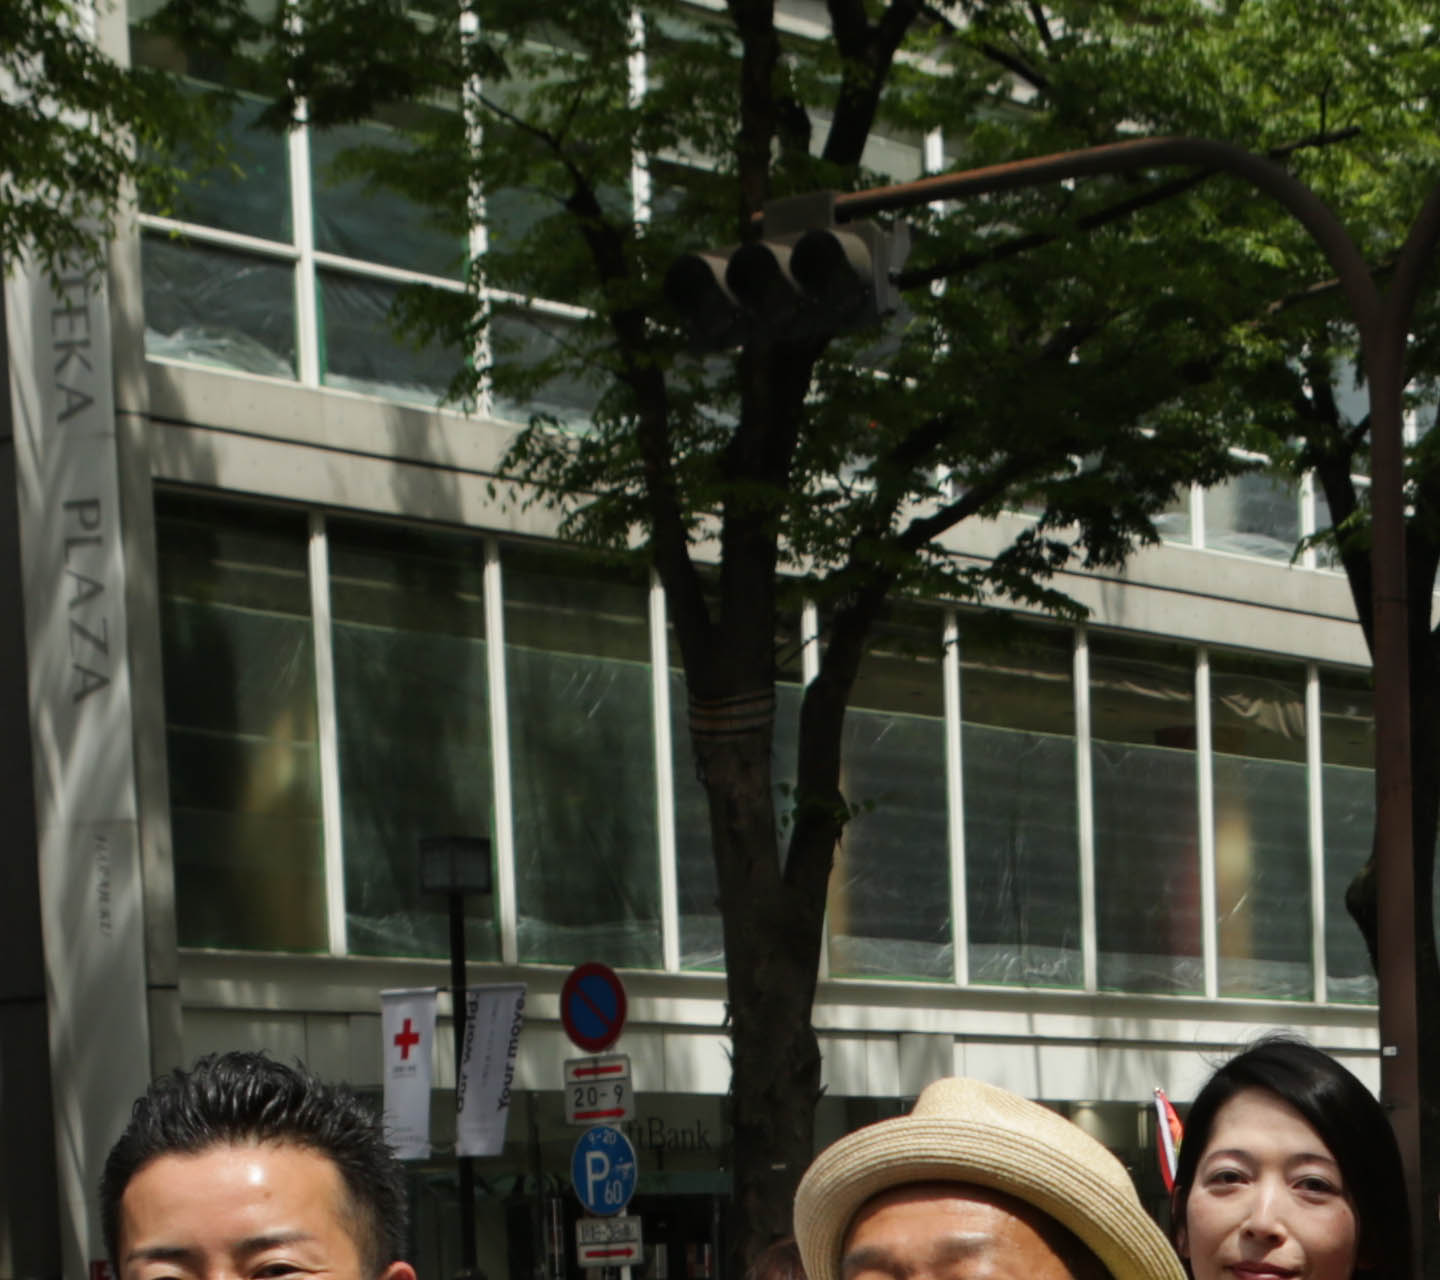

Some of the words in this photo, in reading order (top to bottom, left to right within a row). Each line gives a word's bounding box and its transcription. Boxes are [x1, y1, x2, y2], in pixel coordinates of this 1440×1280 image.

[49, 258, 97, 425] TEKA
[62, 497, 111, 706] PLAZA
[496, 1063, 515, 1112] Your
[506, 990, 527, 1060] move.
[604, 1179, 624, 1207] 60
